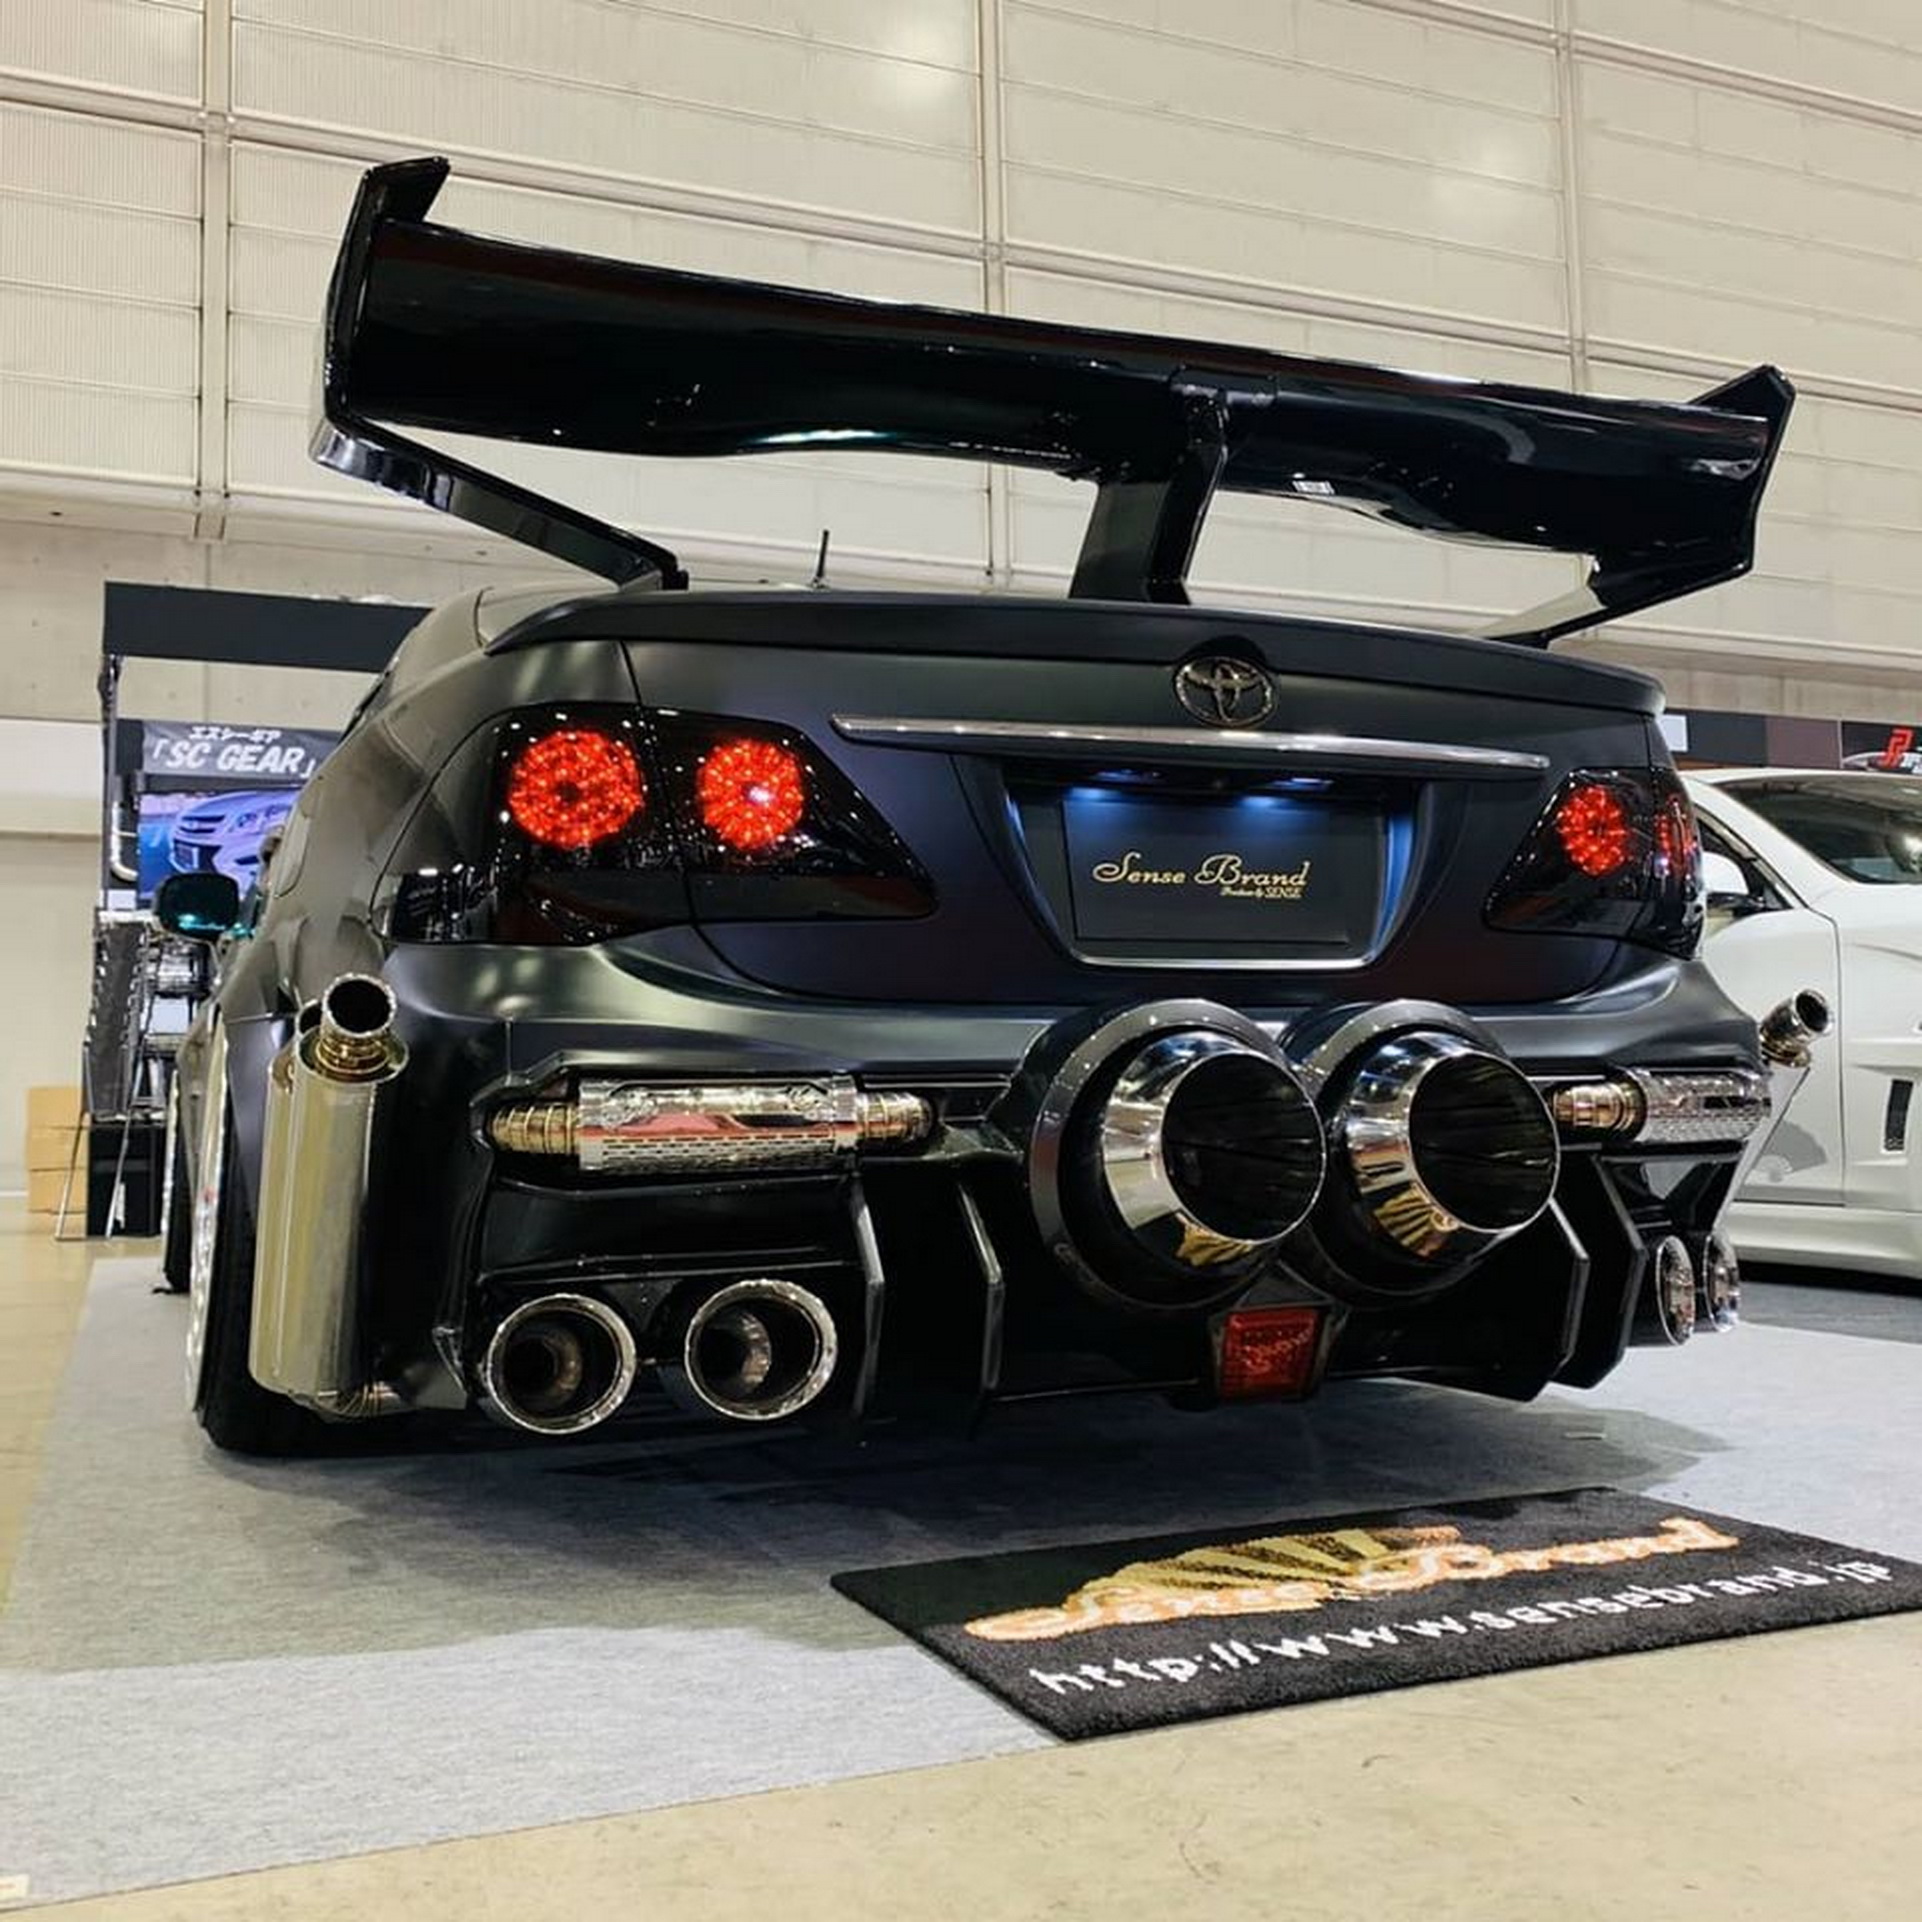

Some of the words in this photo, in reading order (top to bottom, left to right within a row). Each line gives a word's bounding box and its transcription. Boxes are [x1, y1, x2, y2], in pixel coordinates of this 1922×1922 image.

[1092, 851, 1186, 883] Sense
[1194, 853, 1311, 886] Brand
[1028, 1561, 1893, 1695] http://www.sensebrand.jp
